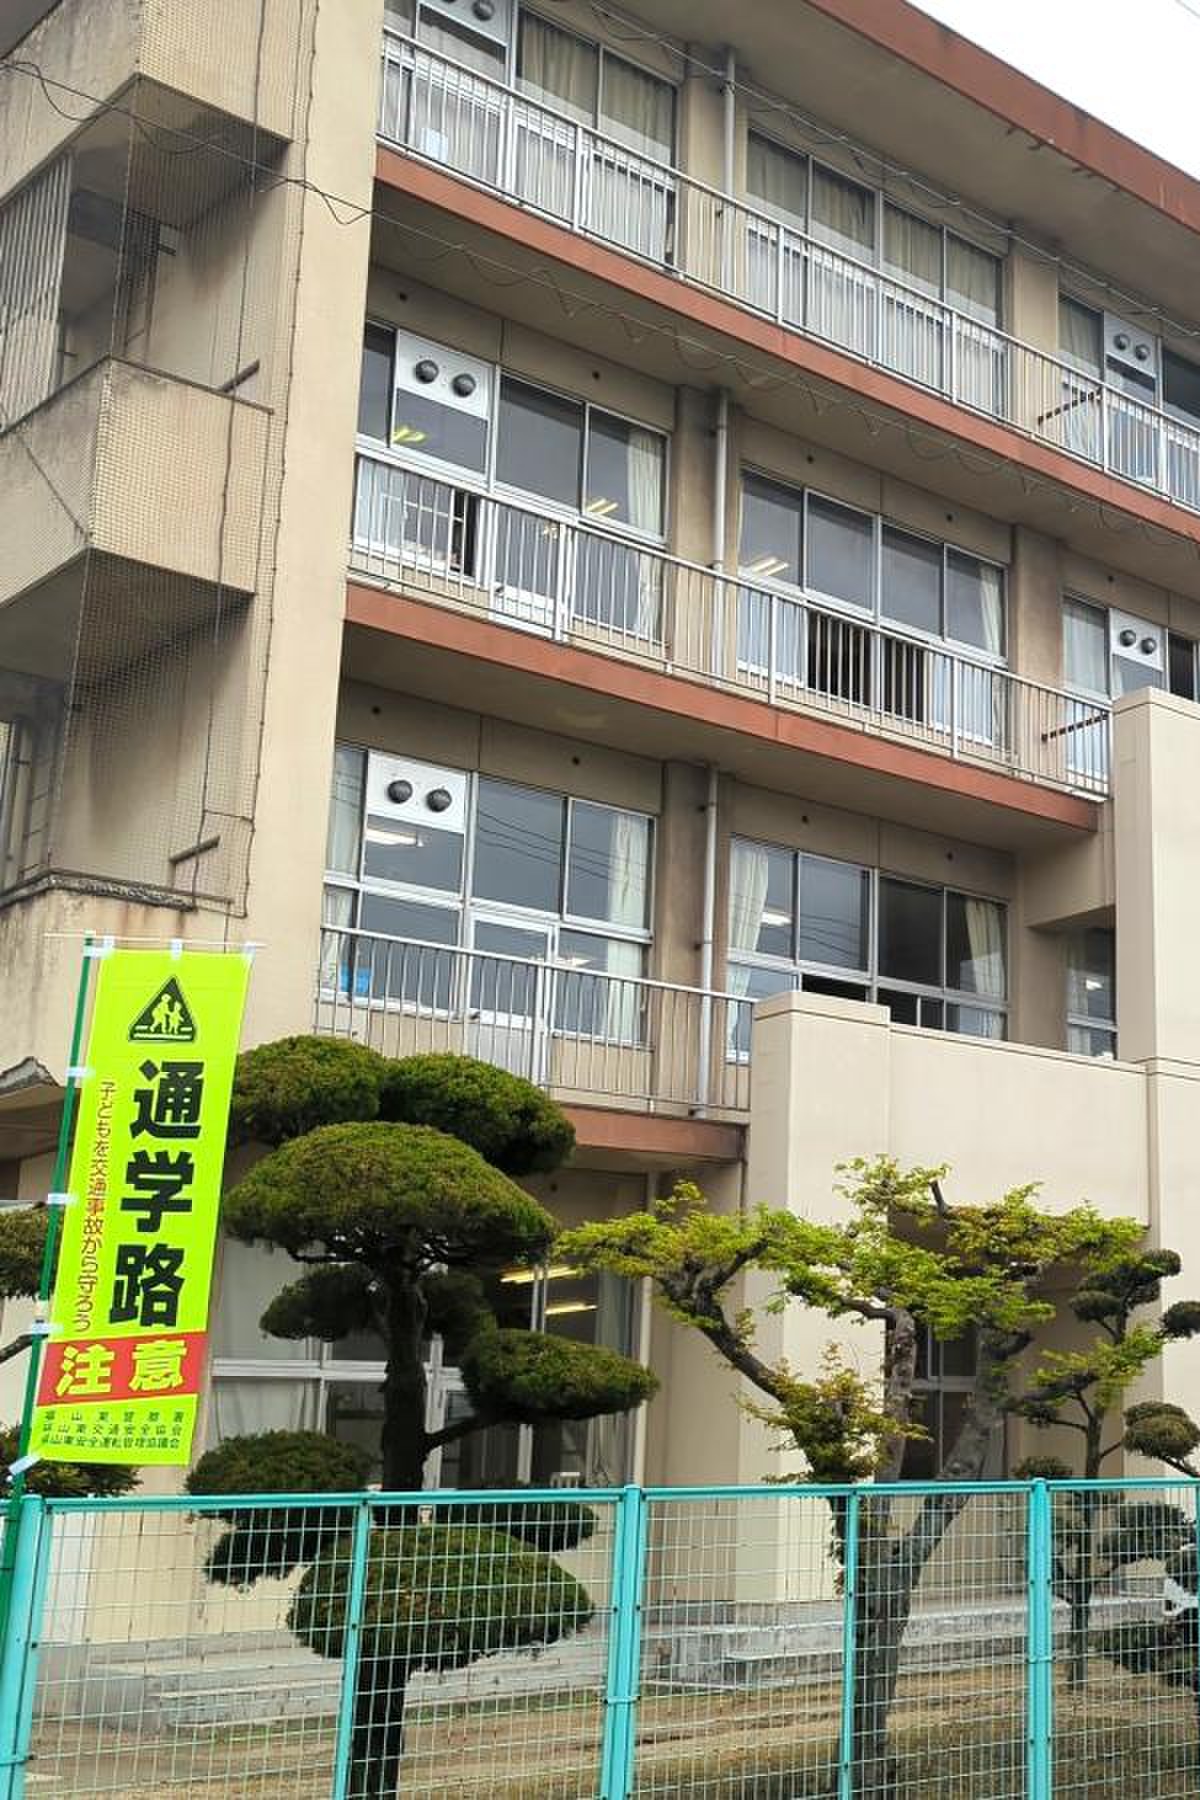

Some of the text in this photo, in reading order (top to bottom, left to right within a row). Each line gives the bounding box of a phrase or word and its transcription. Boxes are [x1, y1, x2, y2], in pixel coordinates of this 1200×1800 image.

[73, 1081, 115, 1332] 子どもを交通事故から守ろう
[110, 1059, 205, 1328] 通学路
[55, 1340, 187, 1397] 注意
